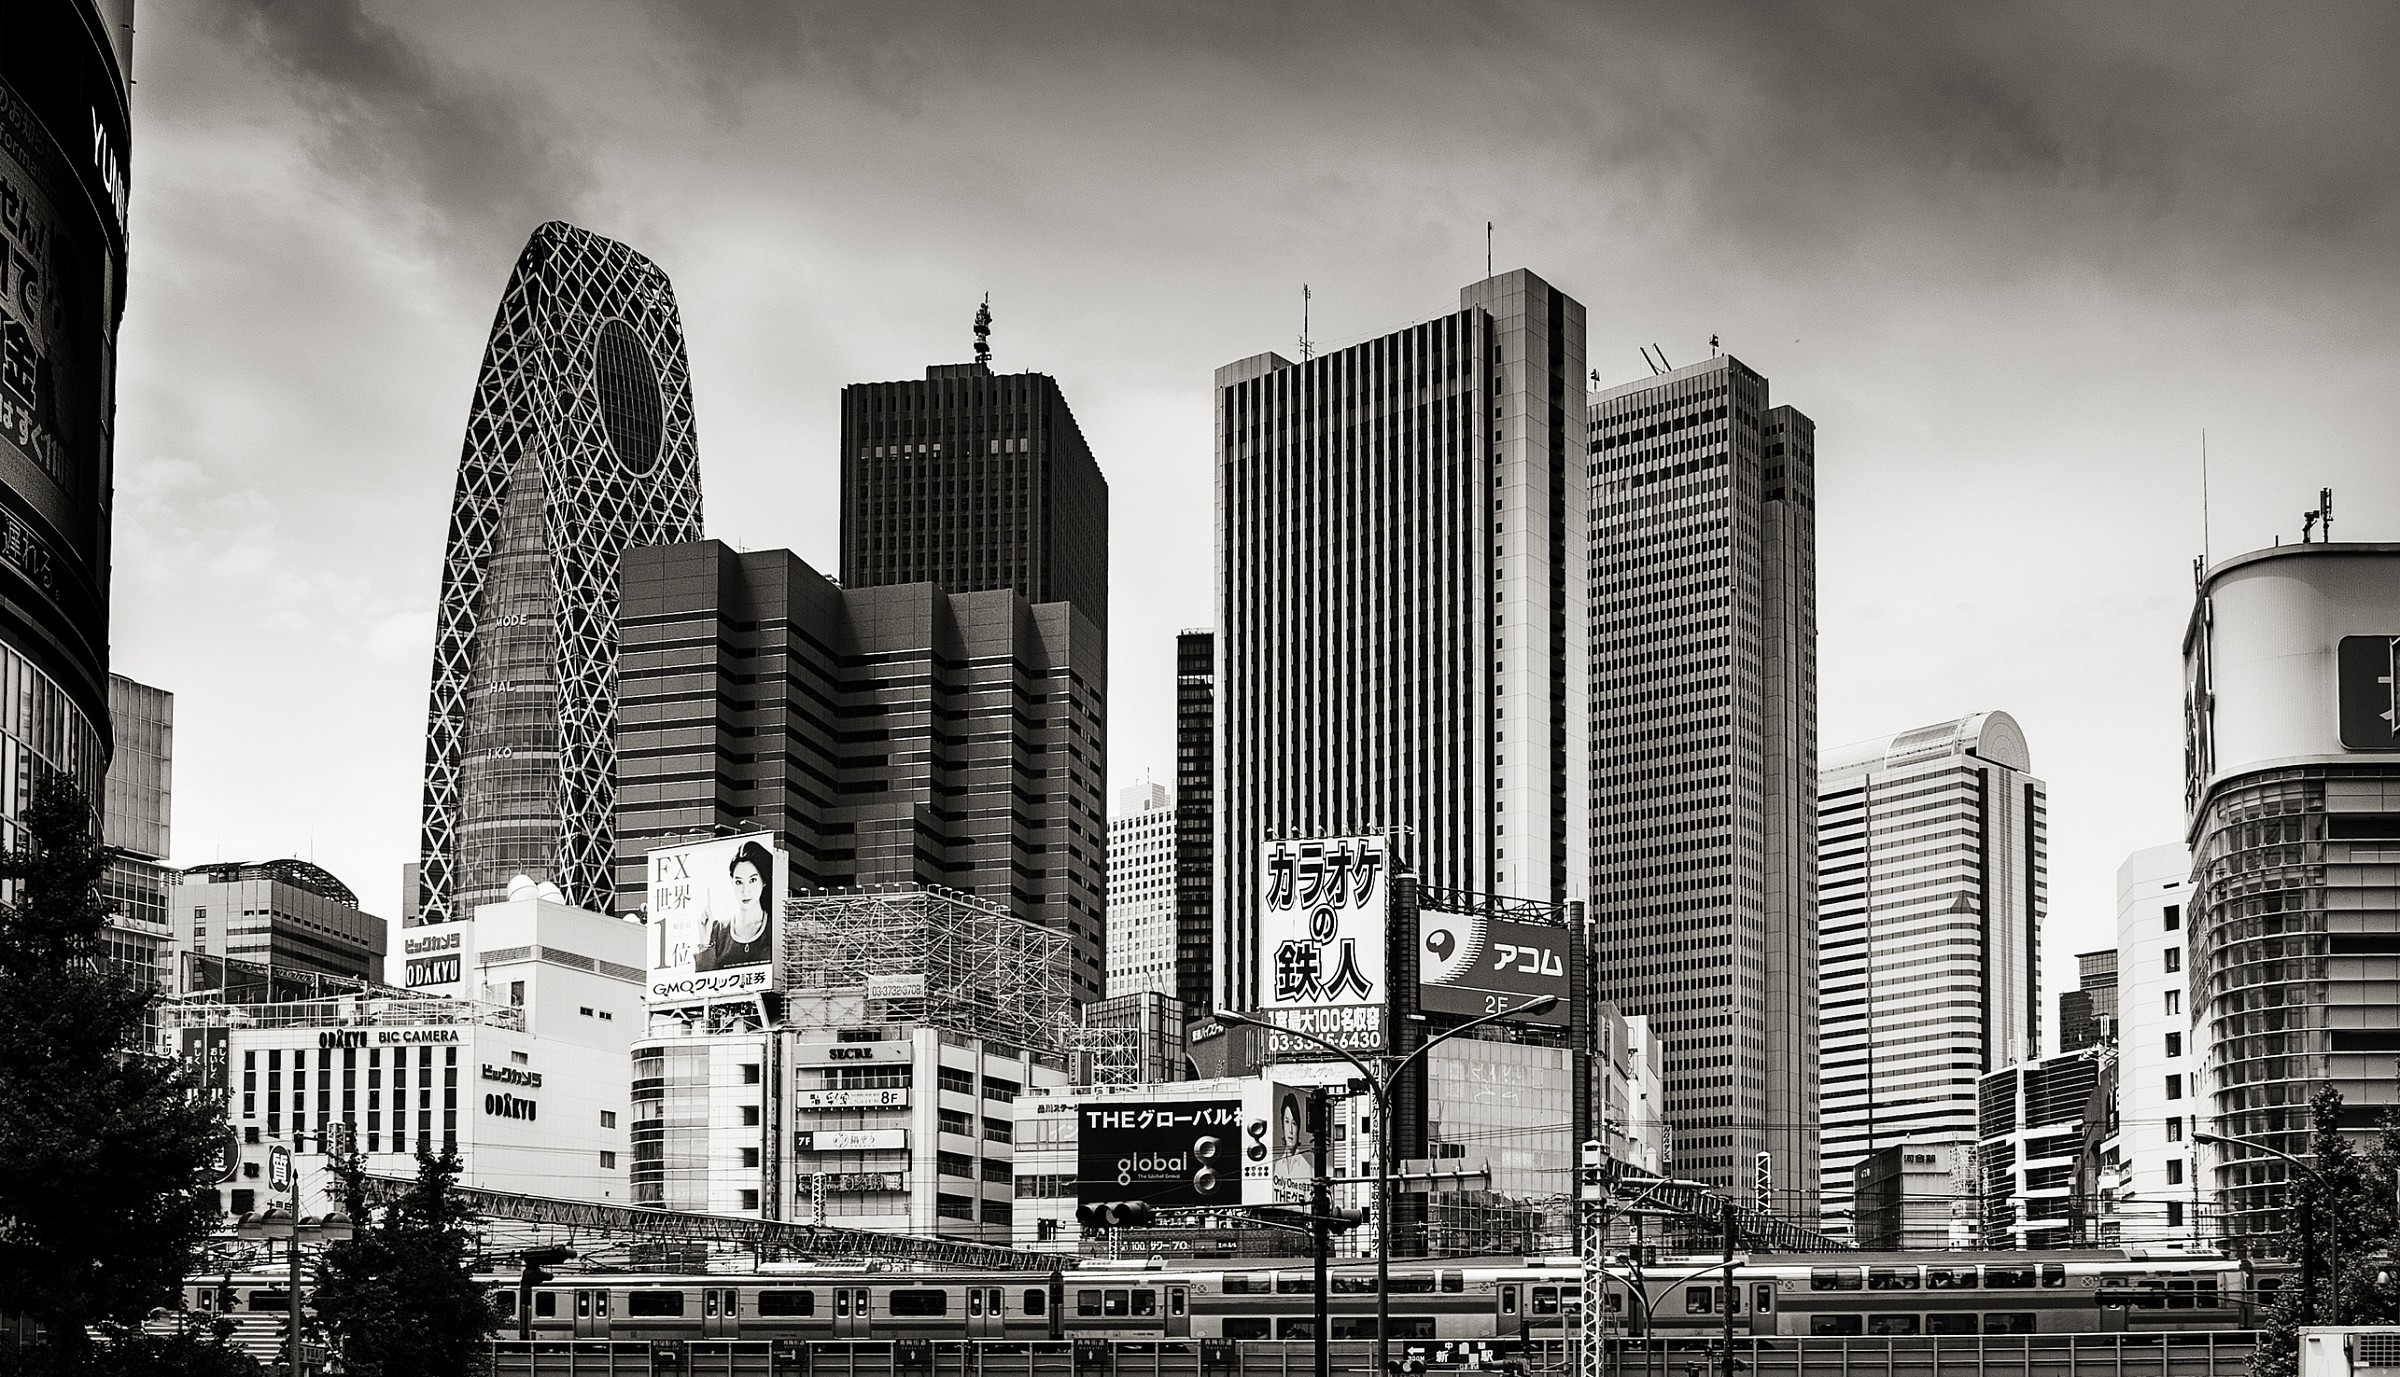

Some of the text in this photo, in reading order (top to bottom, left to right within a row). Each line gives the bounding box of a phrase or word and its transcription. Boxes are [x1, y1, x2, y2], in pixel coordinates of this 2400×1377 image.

[490, 681, 517, 693] HAL
[655, 853, 691, 883] FX
[1266, 839, 1384, 912] カラオケ
[654, 884, 691, 912] 世界
[1309, 903, 1338, 944] の
[405, 933, 460, 954] ビックカメラ
[406, 959, 458, 986] ODAKYU
[1273, 937, 1373, 1003] 鉄人
[1494, 943, 1564, 977] アコム
[1485, 996, 1508, 1014] 2F
[319, 1029, 459, 1048] ODAKYU BIC CAMERA
[829, 1047, 873, 1060] SECRE
[481, 1063, 542, 1088] ビックカメラ
[485, 1092, 537, 1121] ODAKYU
[881, 1091, 898, 1105] 8F
[798, 1137, 811, 1146] 7F
[272, 1152, 288, 1186] 質
[1118, 1151, 1187, 1186] global
